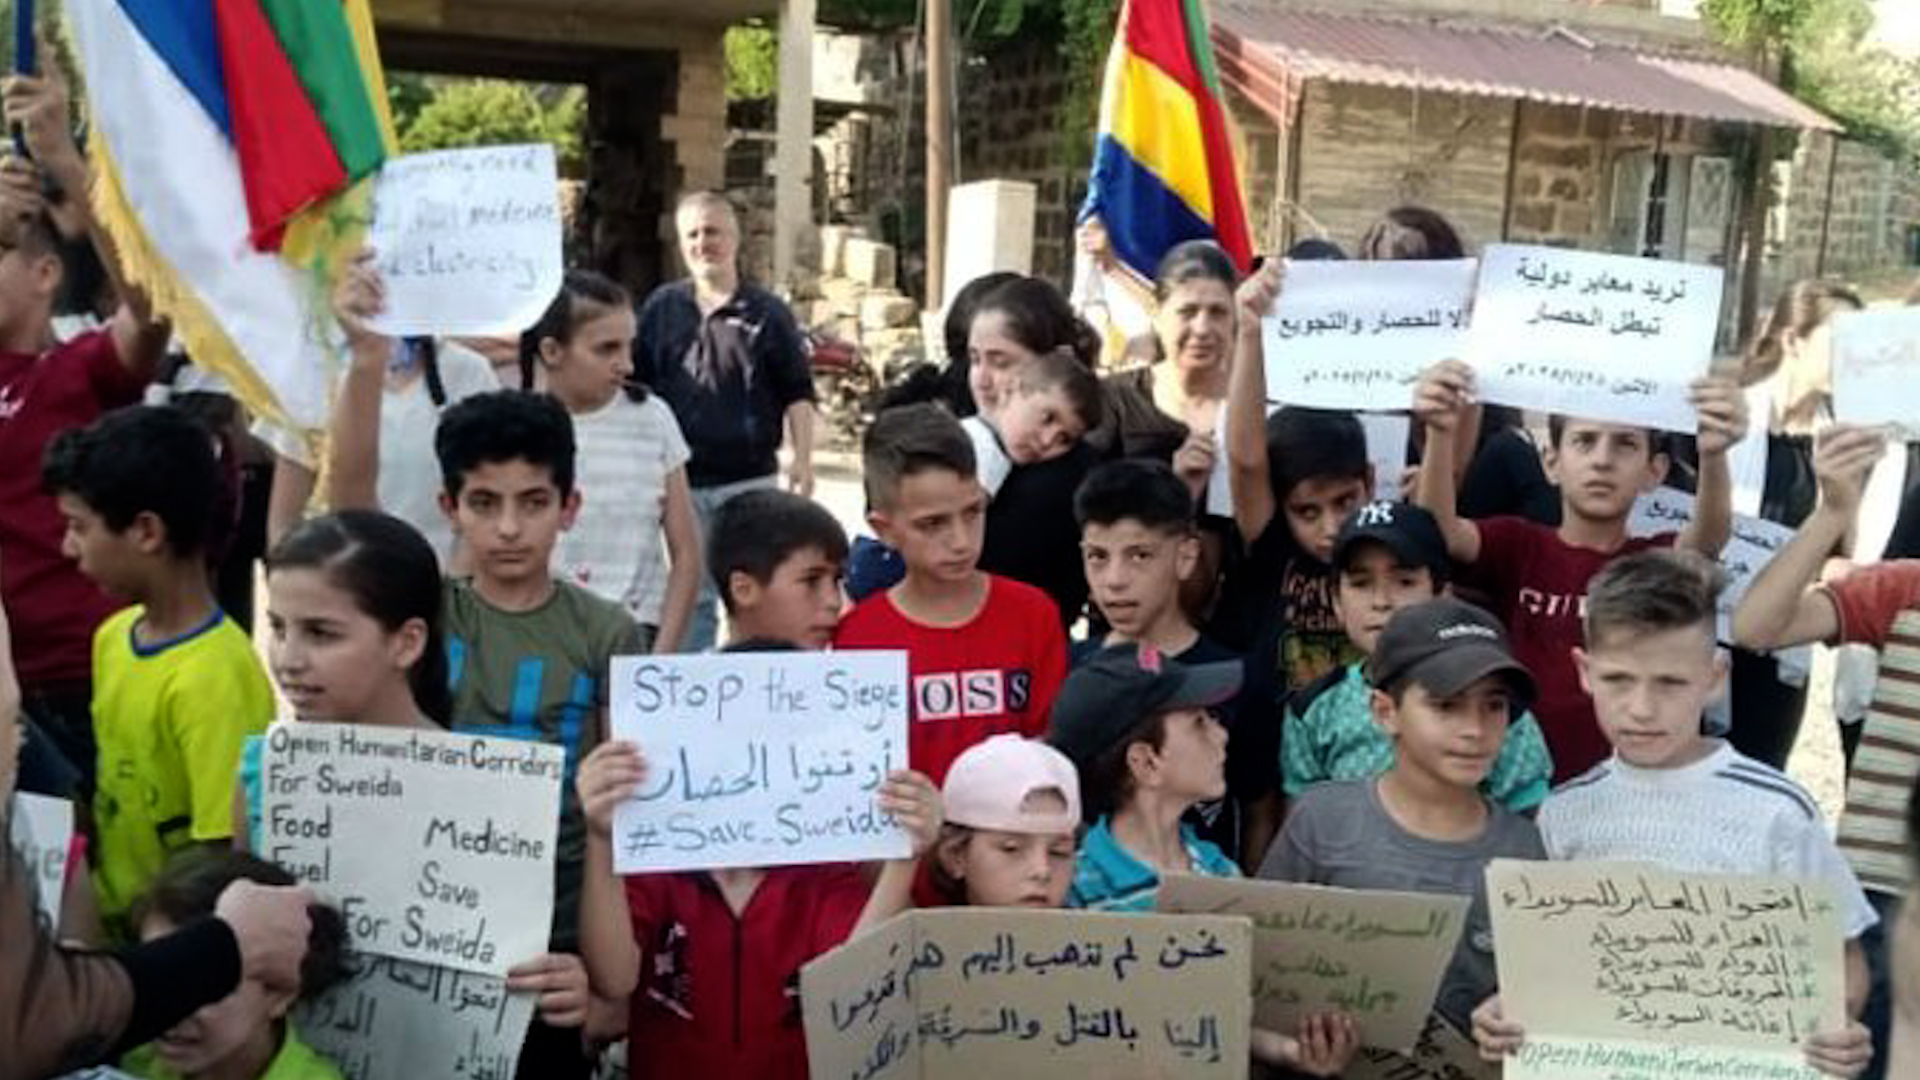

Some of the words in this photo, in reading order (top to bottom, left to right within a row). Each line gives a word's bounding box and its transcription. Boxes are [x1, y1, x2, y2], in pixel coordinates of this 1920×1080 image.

[1372, 307, 1442, 336] للحصار
[1447, 308, 1462, 330] لا
[1526, 301, 1603, 327] الحصار
[764, 667, 810, 714] the
[824, 668, 902, 731] Siege
[270, 726, 331, 766] Open
[269, 763, 308, 794] For
[316, 762, 404, 798] Sweida
[631, 740, 770, 802] الحصار
[271, 802, 332, 838] Food
[423, 816, 546, 861] Medicine
[272, 846, 331, 882] Fuel
[417, 860, 480, 910] Save
[342, 896, 391, 942] For
[401, 903, 497, 966] Sweida
[1158, 930, 1226, 969] نحن
[1113, 937, 1140, 979] لم
